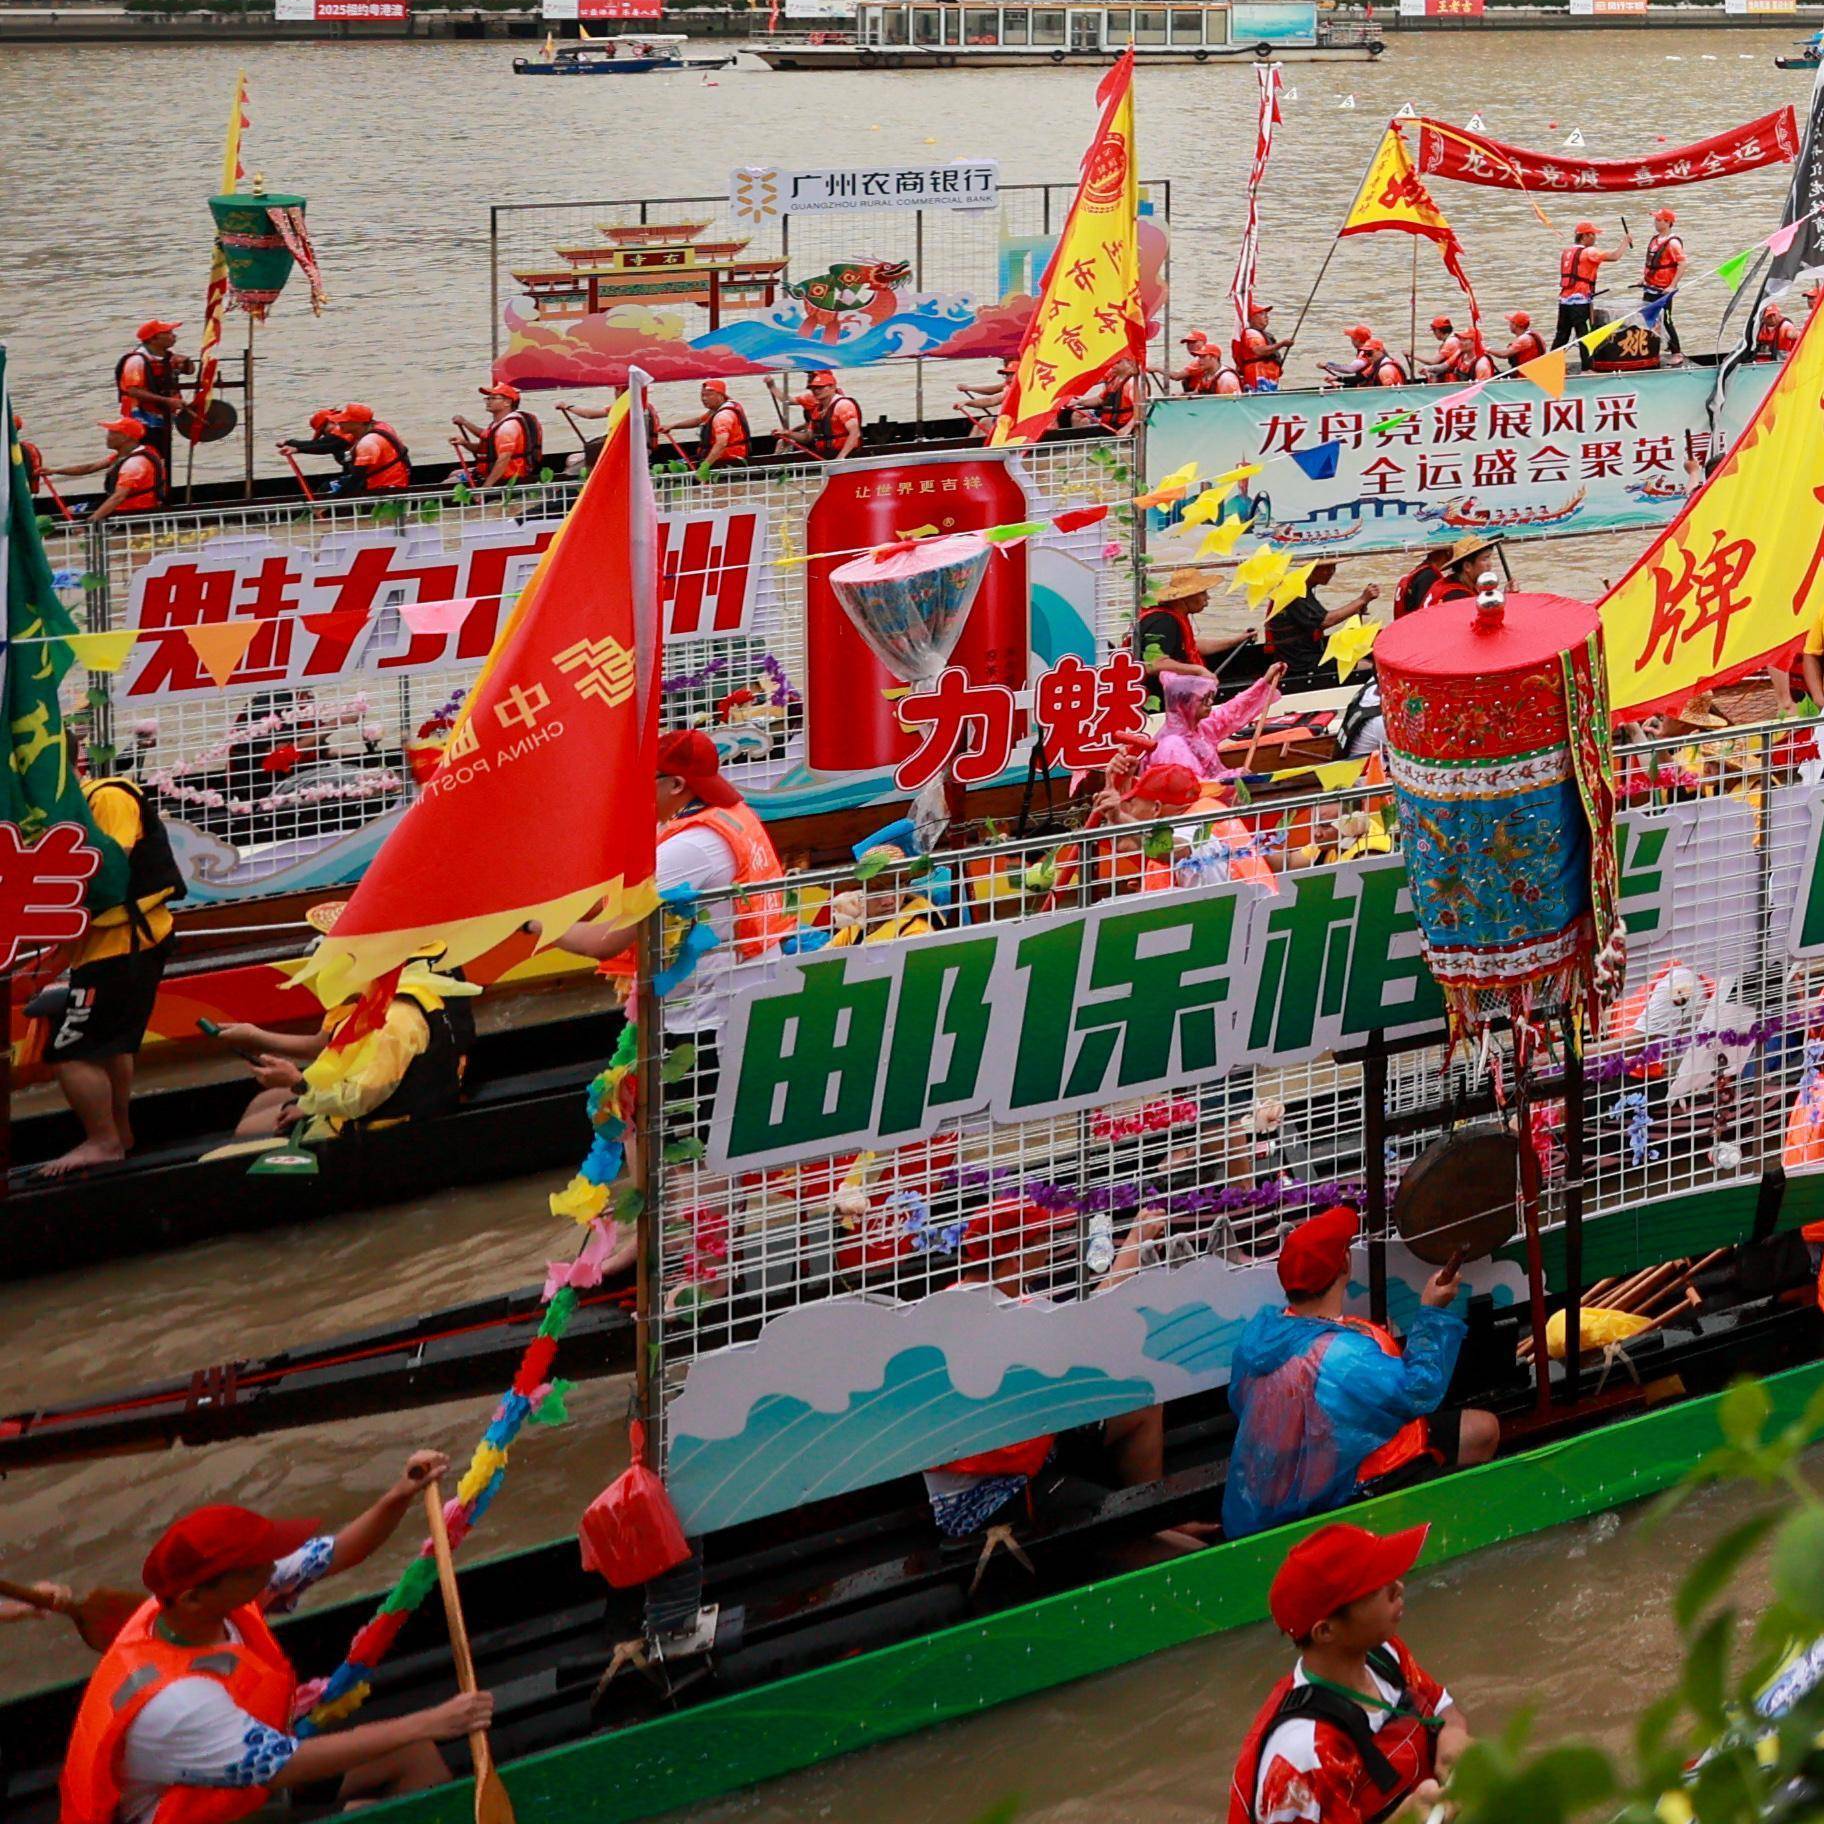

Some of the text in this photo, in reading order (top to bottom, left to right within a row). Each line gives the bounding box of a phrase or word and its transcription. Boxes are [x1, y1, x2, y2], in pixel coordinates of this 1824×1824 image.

[1436, 0, 1473, 14] 王老吉
[1400, 104, 1411, 117] 4
[1470, 118, 1481, 131] 3
[1570, 131, 1581, 144] 2
[1627, 136, 1764, 188] 喜迎全运
[790, 168, 994, 199] 广州农商银行
[790, 194, 994, 211] GUANGZHOU RURAL COMMERCIAL BANK
[1257, 392, 1639, 457] 龙舟竞渡展风采
[855, 475, 983, 499] 让世界更吉祥
[53, 984, 96, 1051] FILA
